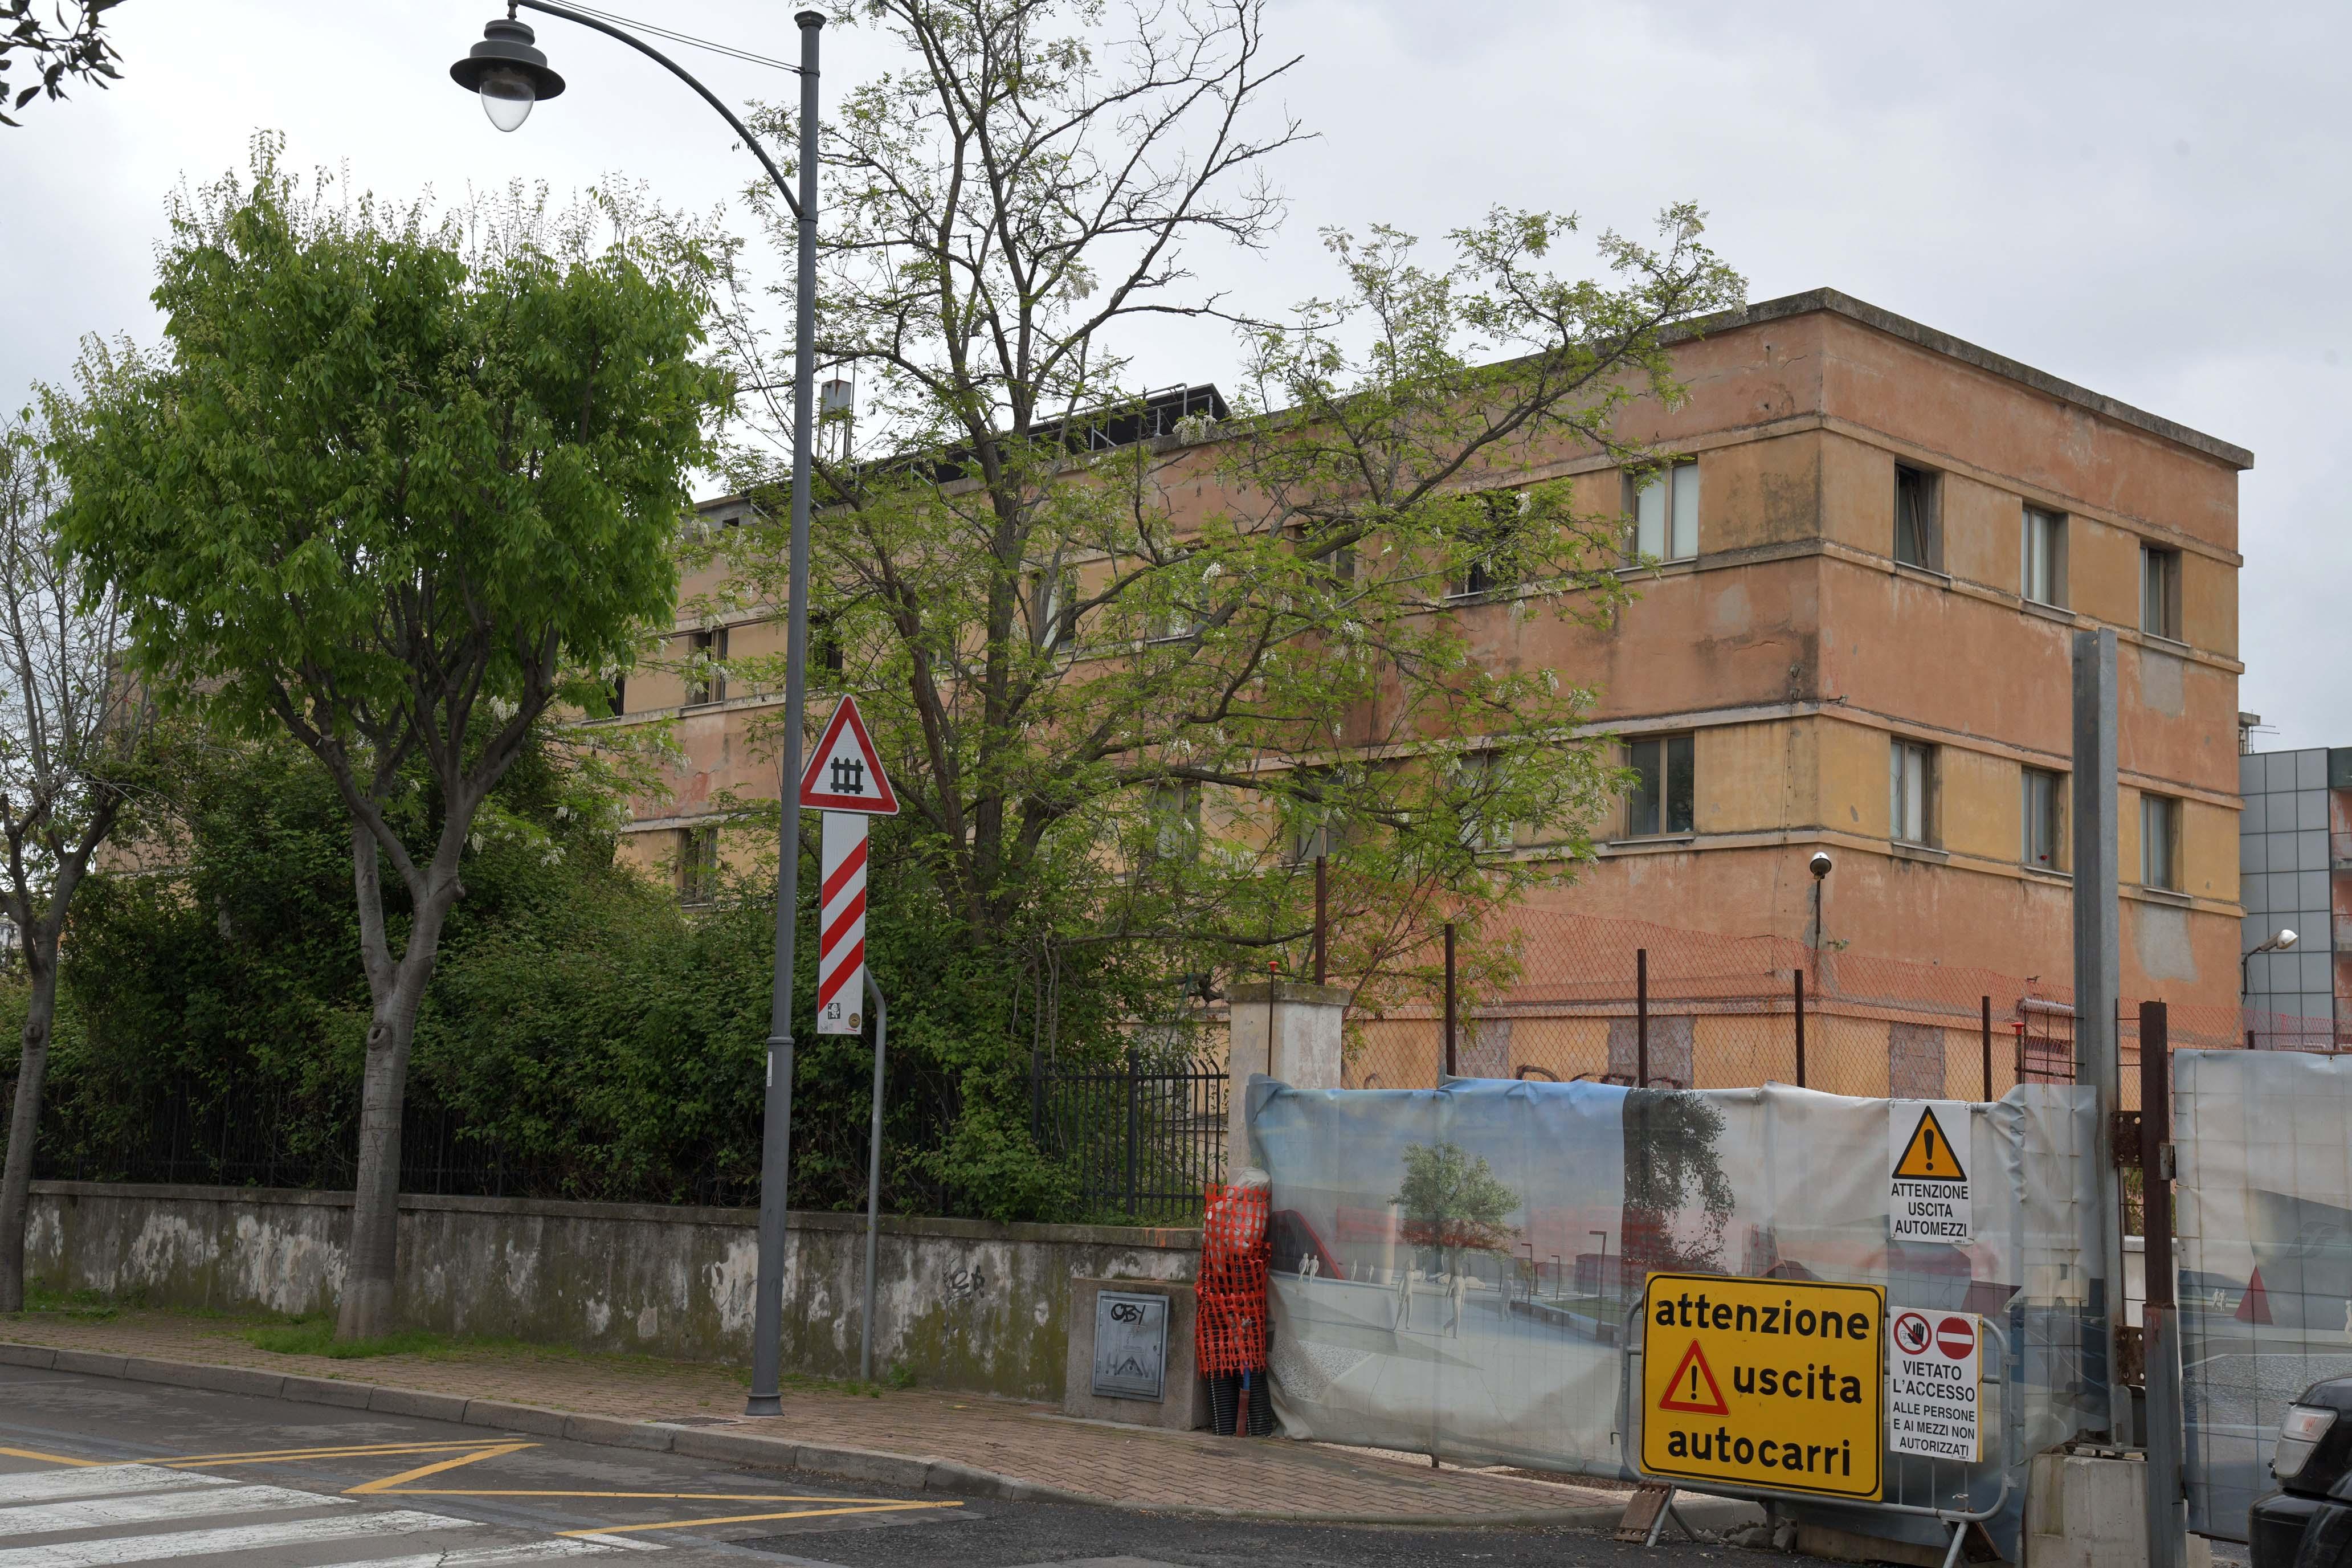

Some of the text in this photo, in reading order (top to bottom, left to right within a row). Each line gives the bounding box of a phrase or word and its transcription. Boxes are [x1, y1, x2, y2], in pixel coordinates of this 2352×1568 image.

[1891, 1183, 1969, 1199] ATTENZIONE
[1908, 1202, 1953, 1218] USCITA
[1895, 1220, 1967, 1237] AUTOMEZZI
[1655, 1293, 1870, 1341] attenzione
[1903, 1360, 1962, 1381] VIETATO
[1734, 1363, 1863, 1404] uscita
[1893, 1379, 1975, 1402] L'ACCESSO
[1893, 1402, 1975, 1422] ALLE PERSONE
[1894, 1419, 1975, 1439] E AI MEZZI NON
[1668, 1427, 1850, 1477] autocarri
[1900, 1436, 1969, 1456] AUTORIZZATI
